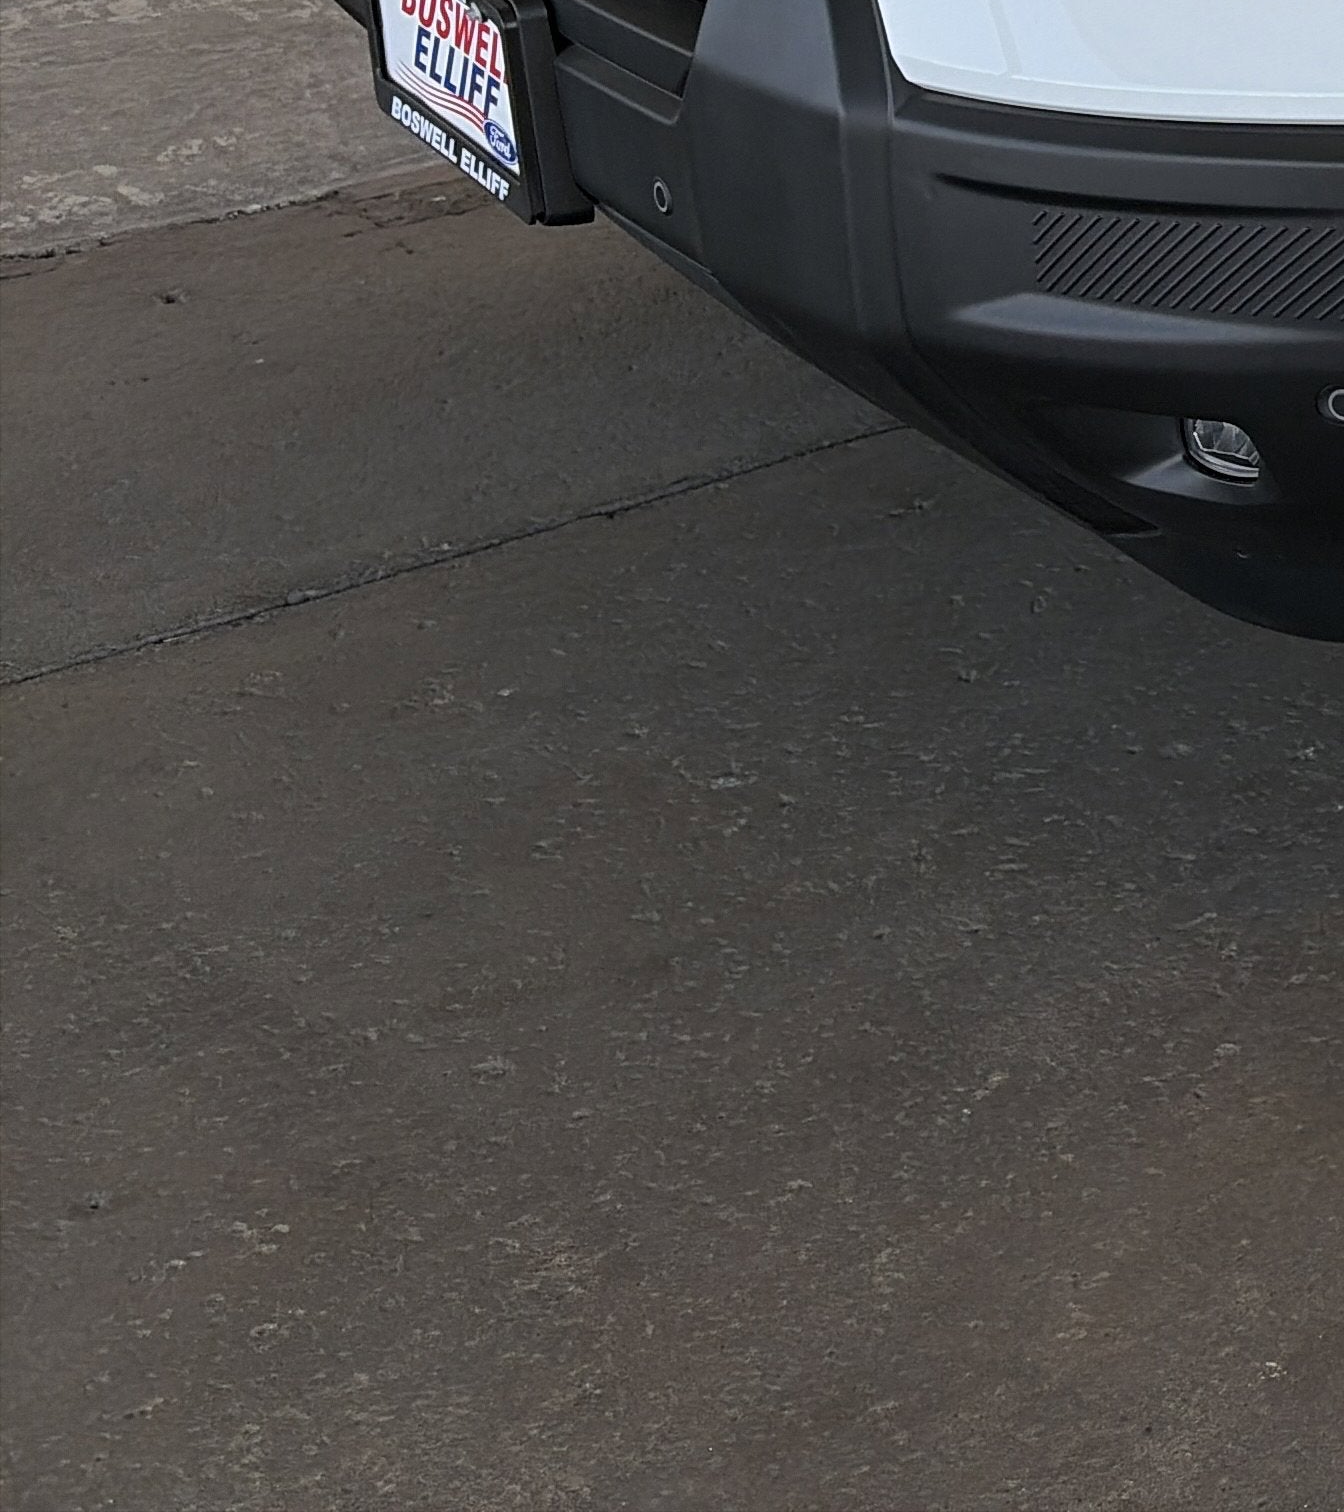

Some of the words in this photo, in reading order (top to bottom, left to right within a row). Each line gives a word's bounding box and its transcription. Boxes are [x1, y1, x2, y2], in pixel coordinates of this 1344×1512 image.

[414, 24, 501, 118] ELLIFF
[391, 96, 459, 166] BOSWELL
[460, 149, 511, 202] ELLIFF
[487, 123, 512, 159] Ford
